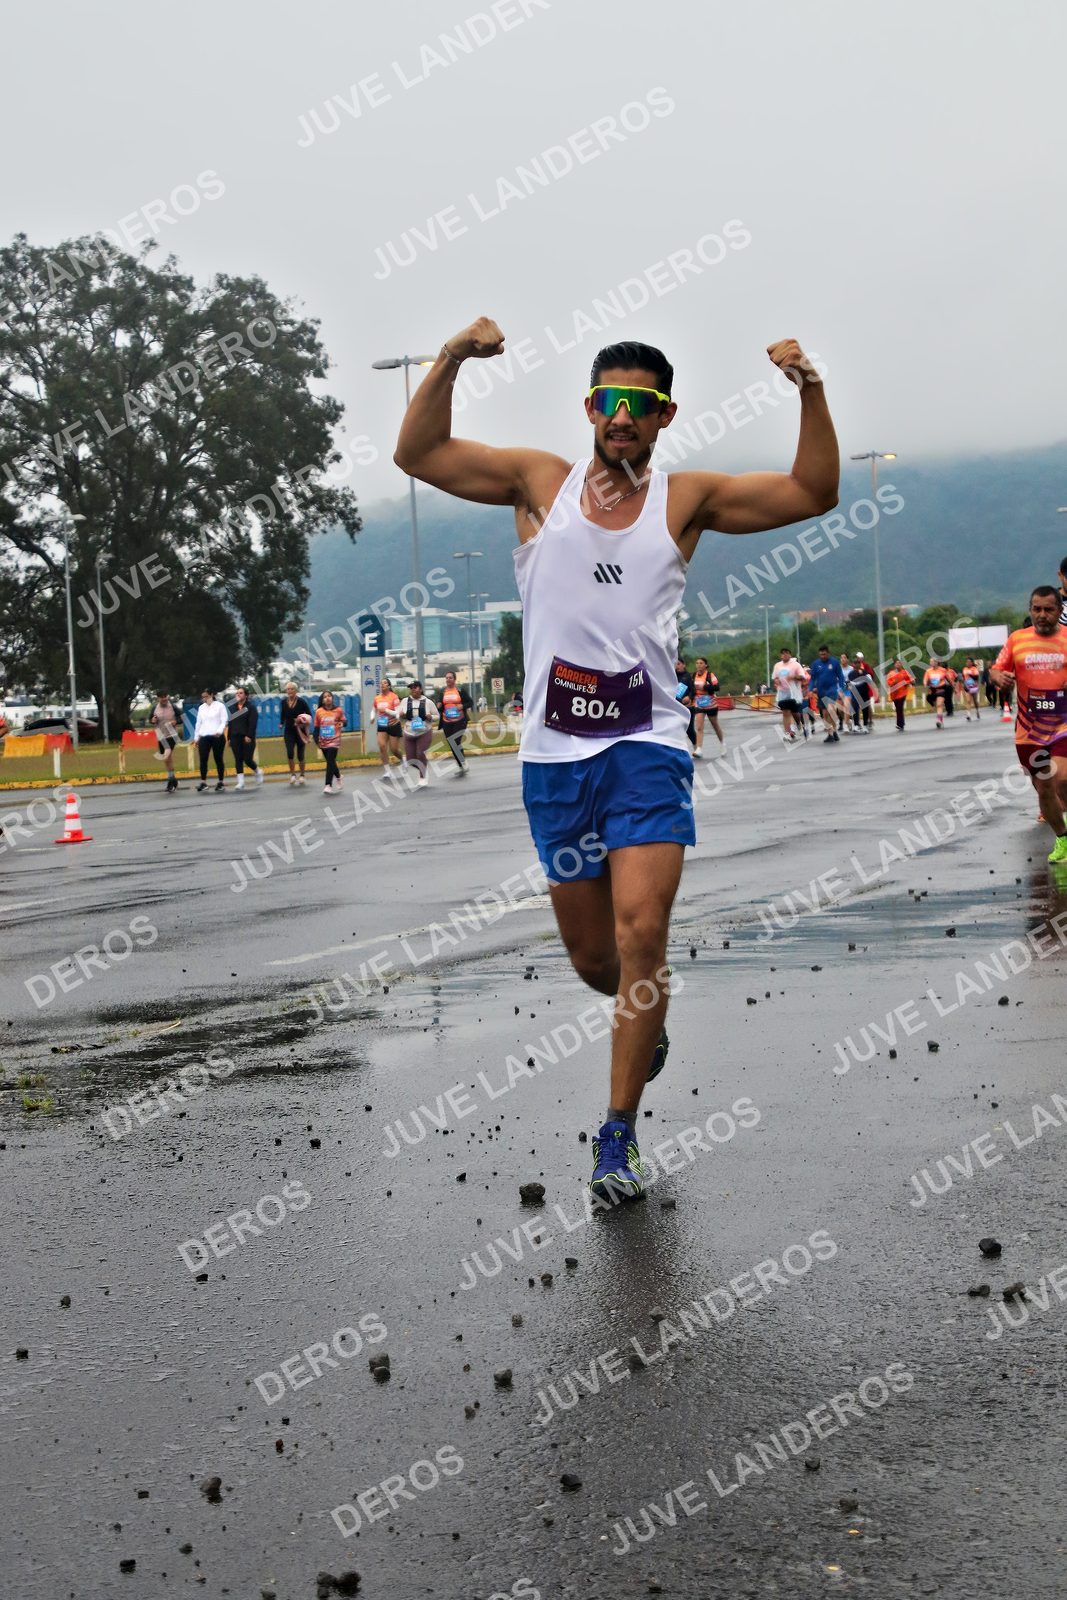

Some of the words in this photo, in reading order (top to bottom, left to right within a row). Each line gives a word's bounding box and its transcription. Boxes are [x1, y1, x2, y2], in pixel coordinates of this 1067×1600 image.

[364, 632, 378, 651] E
[555, 665, 598, 685] CARRERA
[628, 670, 644, 689] 15K
[571, 696, 620, 719] 804
[1035, 700, 1056, 710] 389
